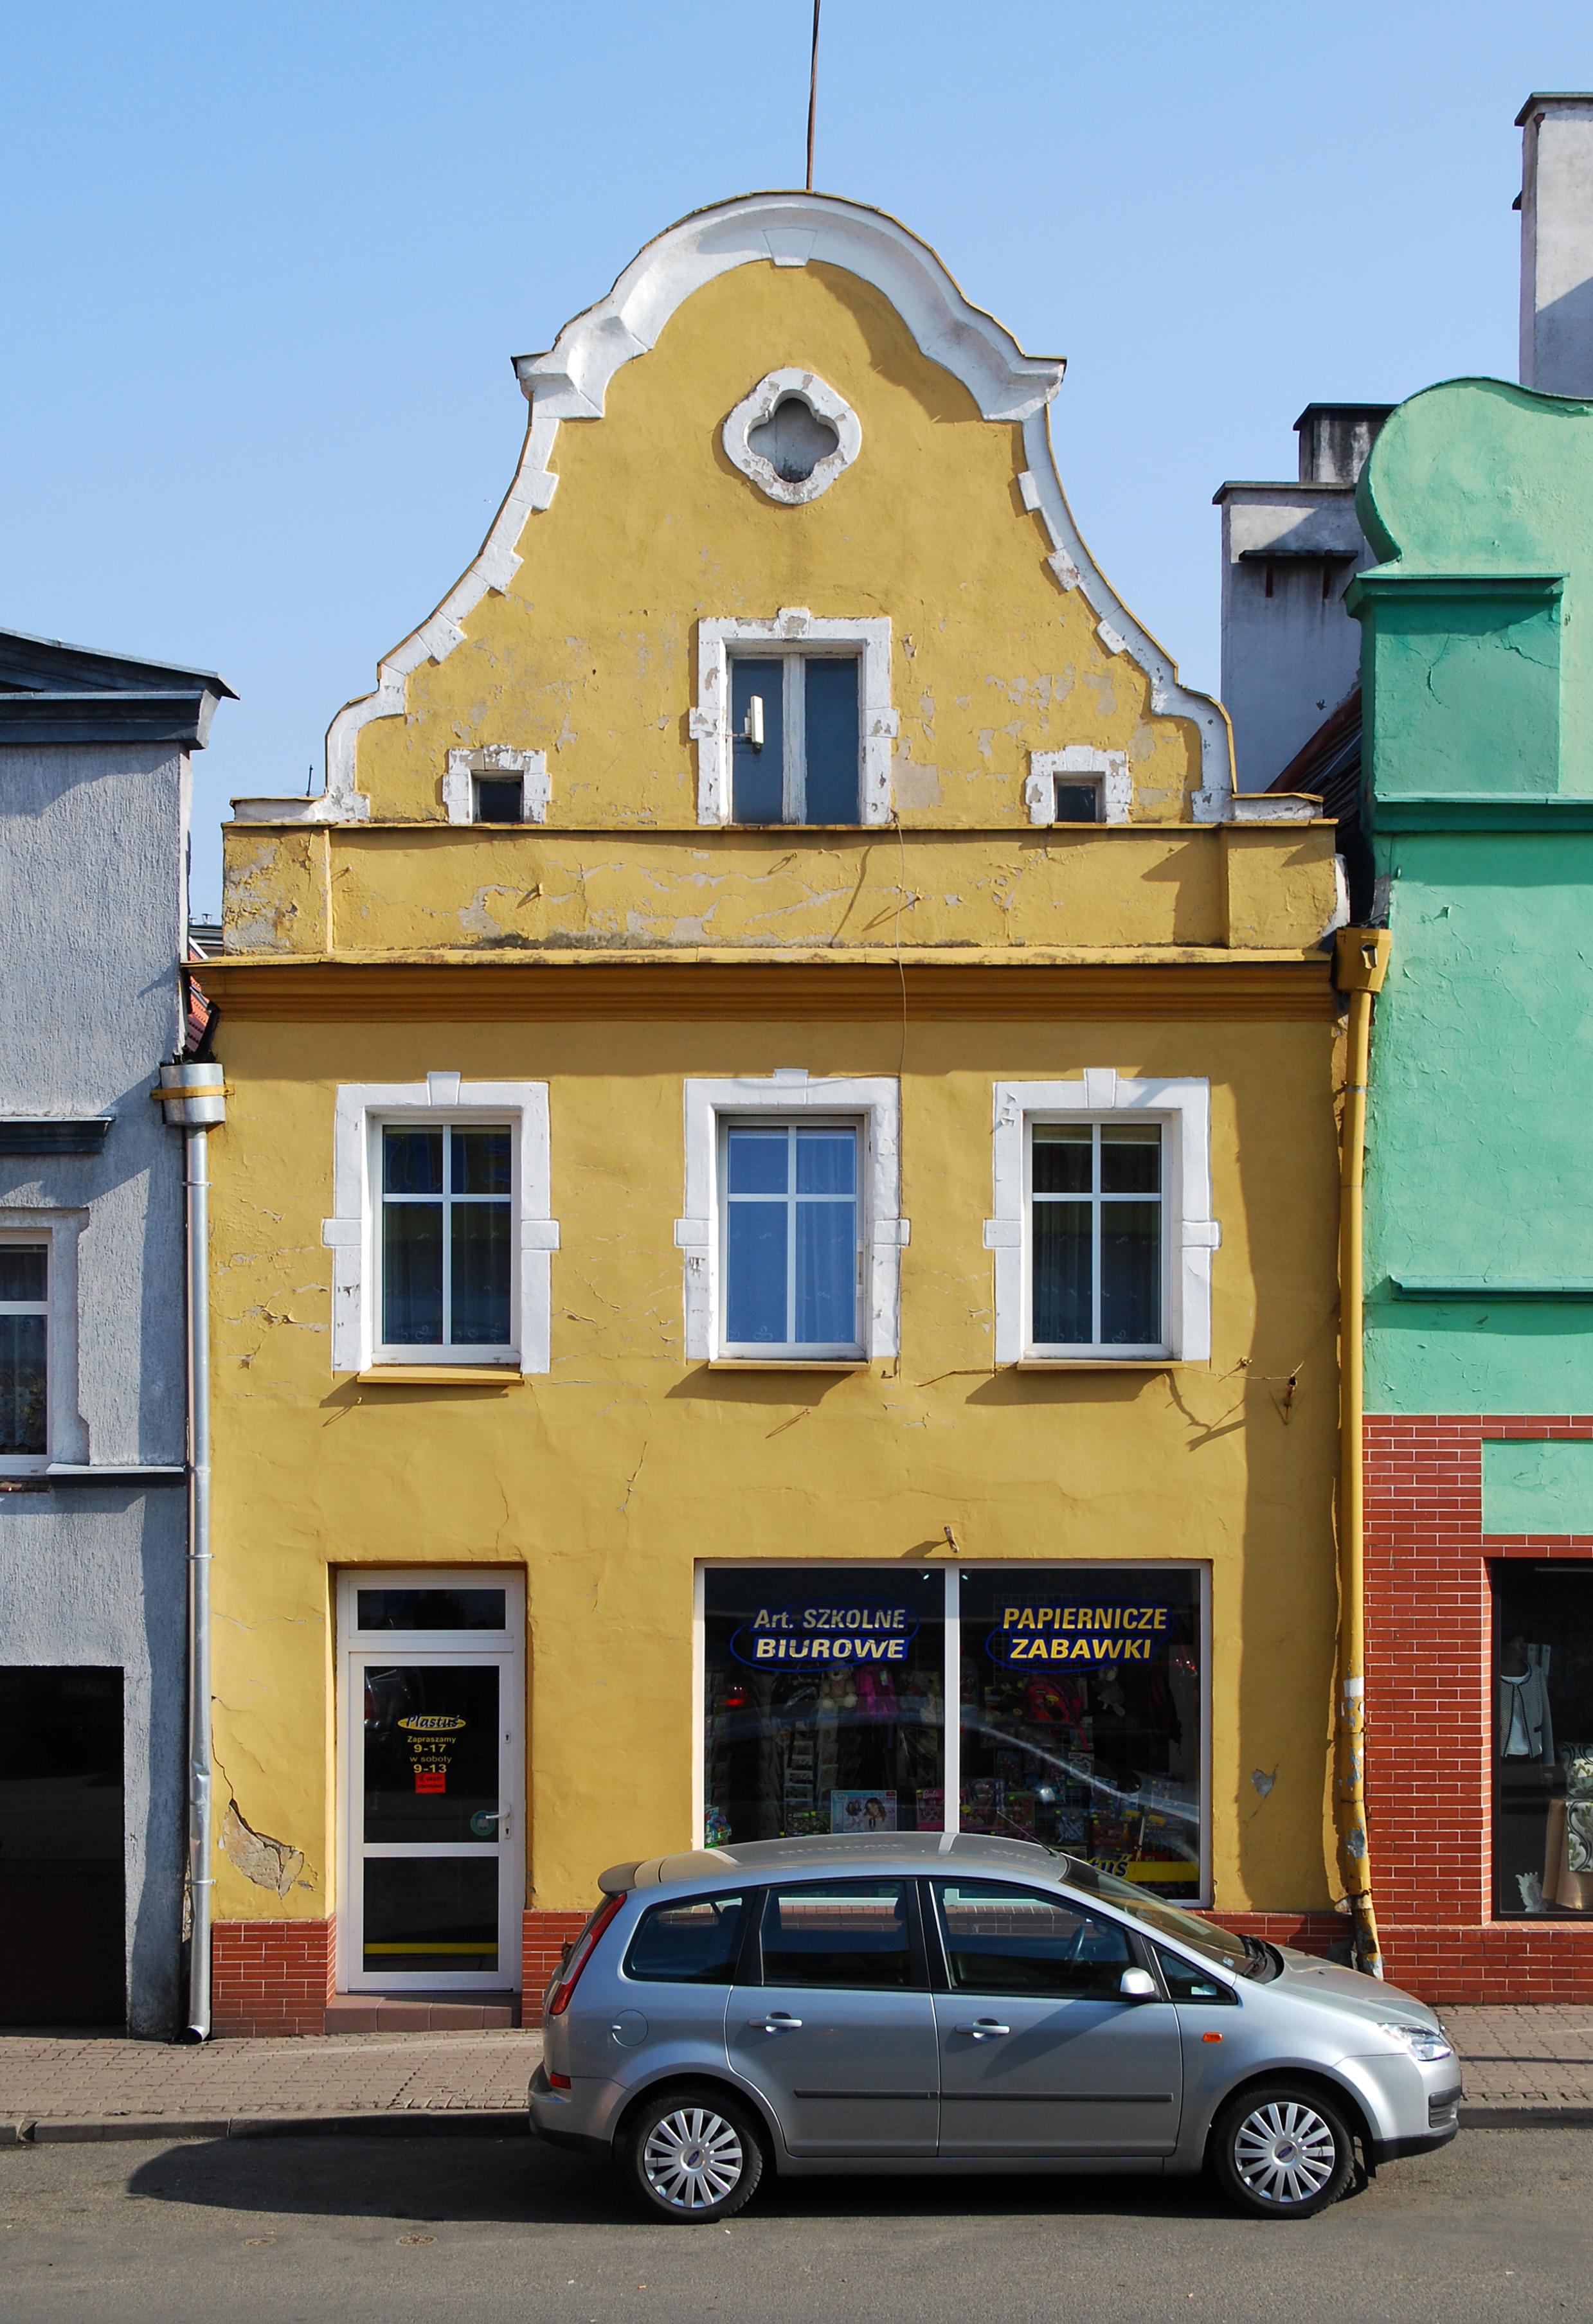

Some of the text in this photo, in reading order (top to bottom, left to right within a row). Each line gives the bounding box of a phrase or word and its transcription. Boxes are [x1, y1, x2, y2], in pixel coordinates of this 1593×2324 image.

[754, 1609, 905, 1628] Art. SZKOLNE
[1003, 1608, 1167, 1629] PAPIERNICZE
[756, 1640, 905, 1658] BIUROWE
[1010, 1640, 1151, 1658] ZABAWKI
[406, 1714, 460, 1728] Plastuś
[413, 1744, 446, 1753] 9-17
[413, 1764, 447, 1773] 9-13
